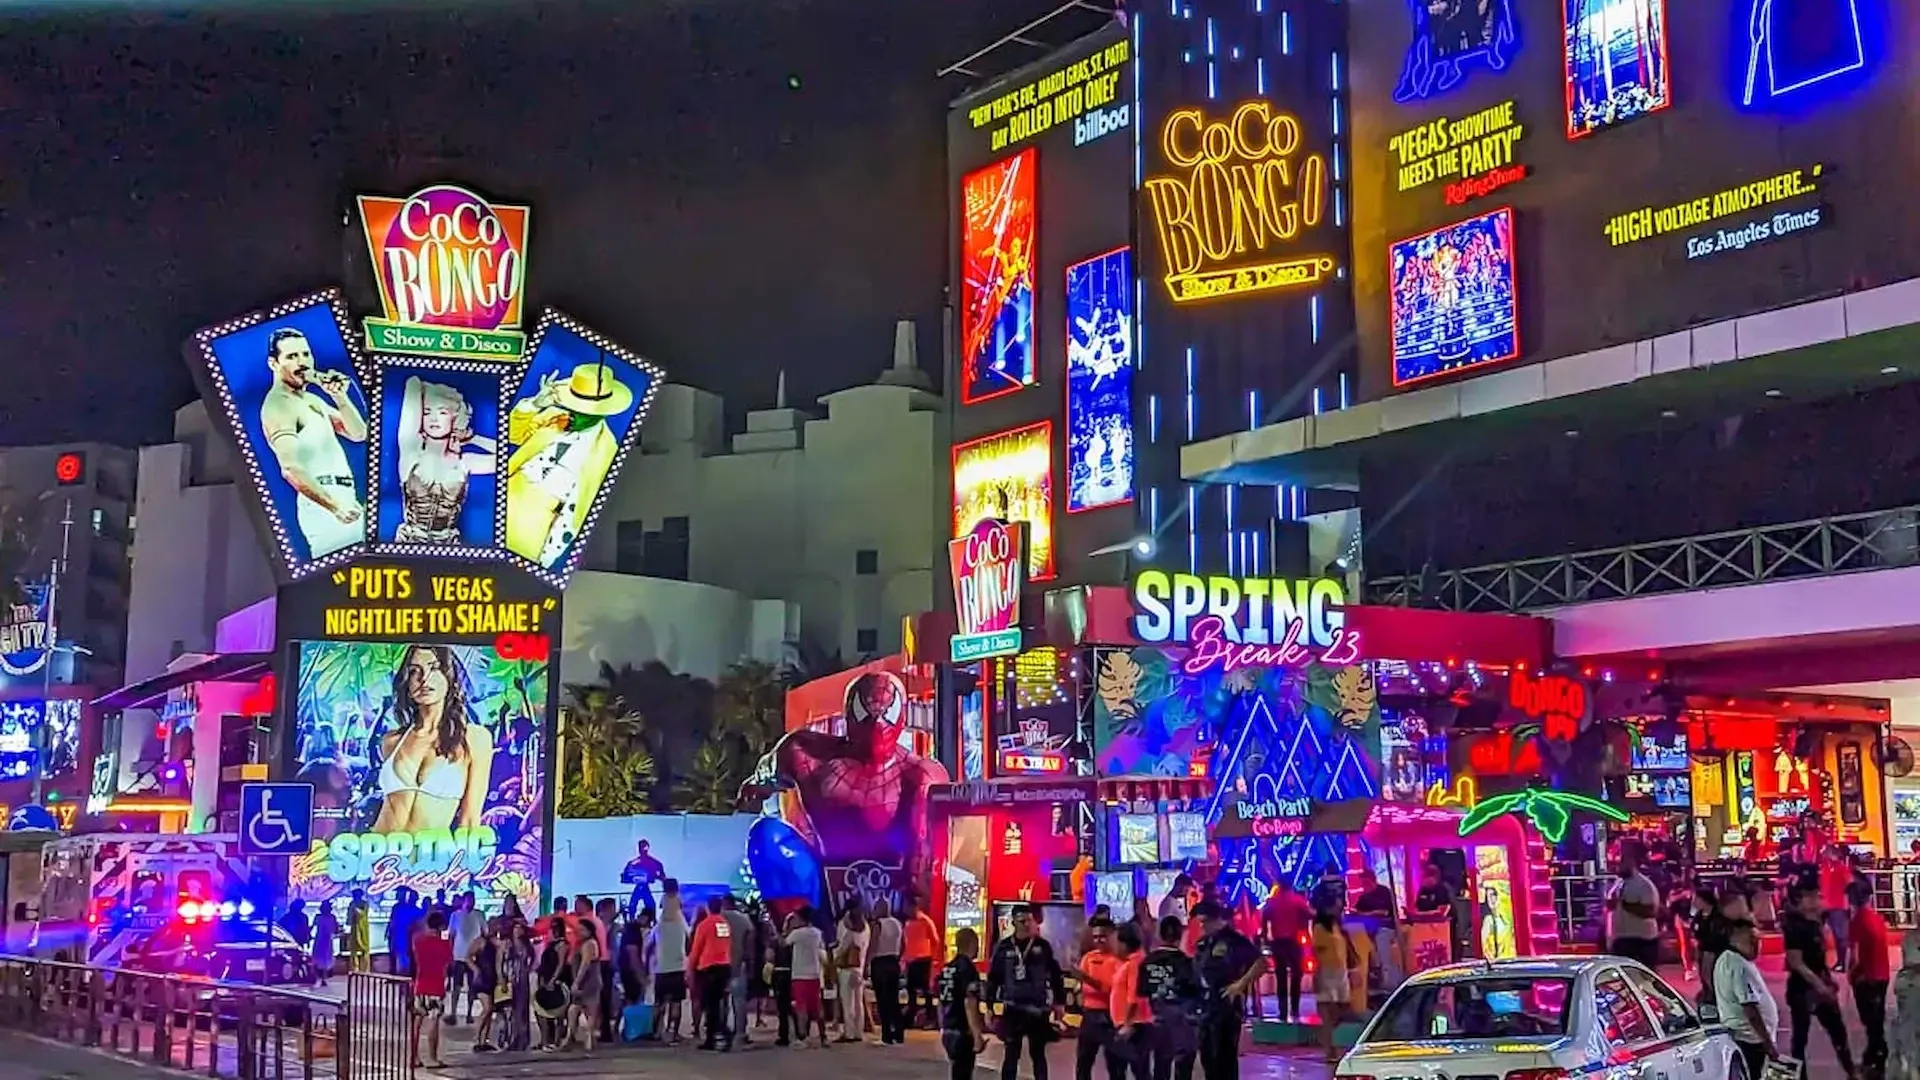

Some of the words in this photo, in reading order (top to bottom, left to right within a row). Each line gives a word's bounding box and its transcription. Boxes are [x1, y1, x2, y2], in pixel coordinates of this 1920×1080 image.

[969, 103, 991, 128] "NEW
[1038, 70, 1065, 100] MARDI
[1066, 59, 1091, 87] GRAS,
[1090, 52, 1104, 76] ST.
[991, 127, 1009, 151] DAY
[1009, 102, 1053, 143] ROLLED
[1053, 87, 1083, 125] INTO
[1163, 103, 1299, 167] CoCo
[1389, 117, 1448, 165] "VEGAS
[1449, 101, 1514, 147] SHOWTIME
[1398, 157, 1435, 191] MEETS
[1435, 148, 1460, 177] THE
[1460, 124, 1523, 178] PARTY"
[400, 199, 501, 245] CoCo
[1604, 208, 1652, 246] "HIGH
[1653, 197, 1711, 234] VOLTAGE
[1686, 237, 1714, 260] Los
[1714, 221, 1771, 251] Angeles
[1772, 208, 1821, 236] Times
[384, 239, 521, 324] BONGO
[1181, 277, 1232, 297] Show
[1235, 271, 1253, 290] &
[1257, 265, 1308, 287] Disco
[383, 329, 435, 349] Show
[439, 334, 456, 349] &
[461, 334, 512, 353] Disco
[966, 528, 1009, 568] CoCo
[331, 567, 411, 599] "PUTS
[431, 577, 494, 601] VEGAS
[960, 557, 1020, 635] BONGO
[1134, 570, 1345, 646] SPRING
[325, 608, 424, 635] NIGHTLIFE
[426, 608, 452, 633] TO
[1184, 617, 1309, 673] Break
[1319, 629, 1361, 664] 23
[1236, 799, 1276, 819] Beach
[327, 825, 500, 882] SPRING
[367, 851, 473, 895] Break
[473, 853, 509, 881] 23
[844, 868, 891, 889] CoCo
